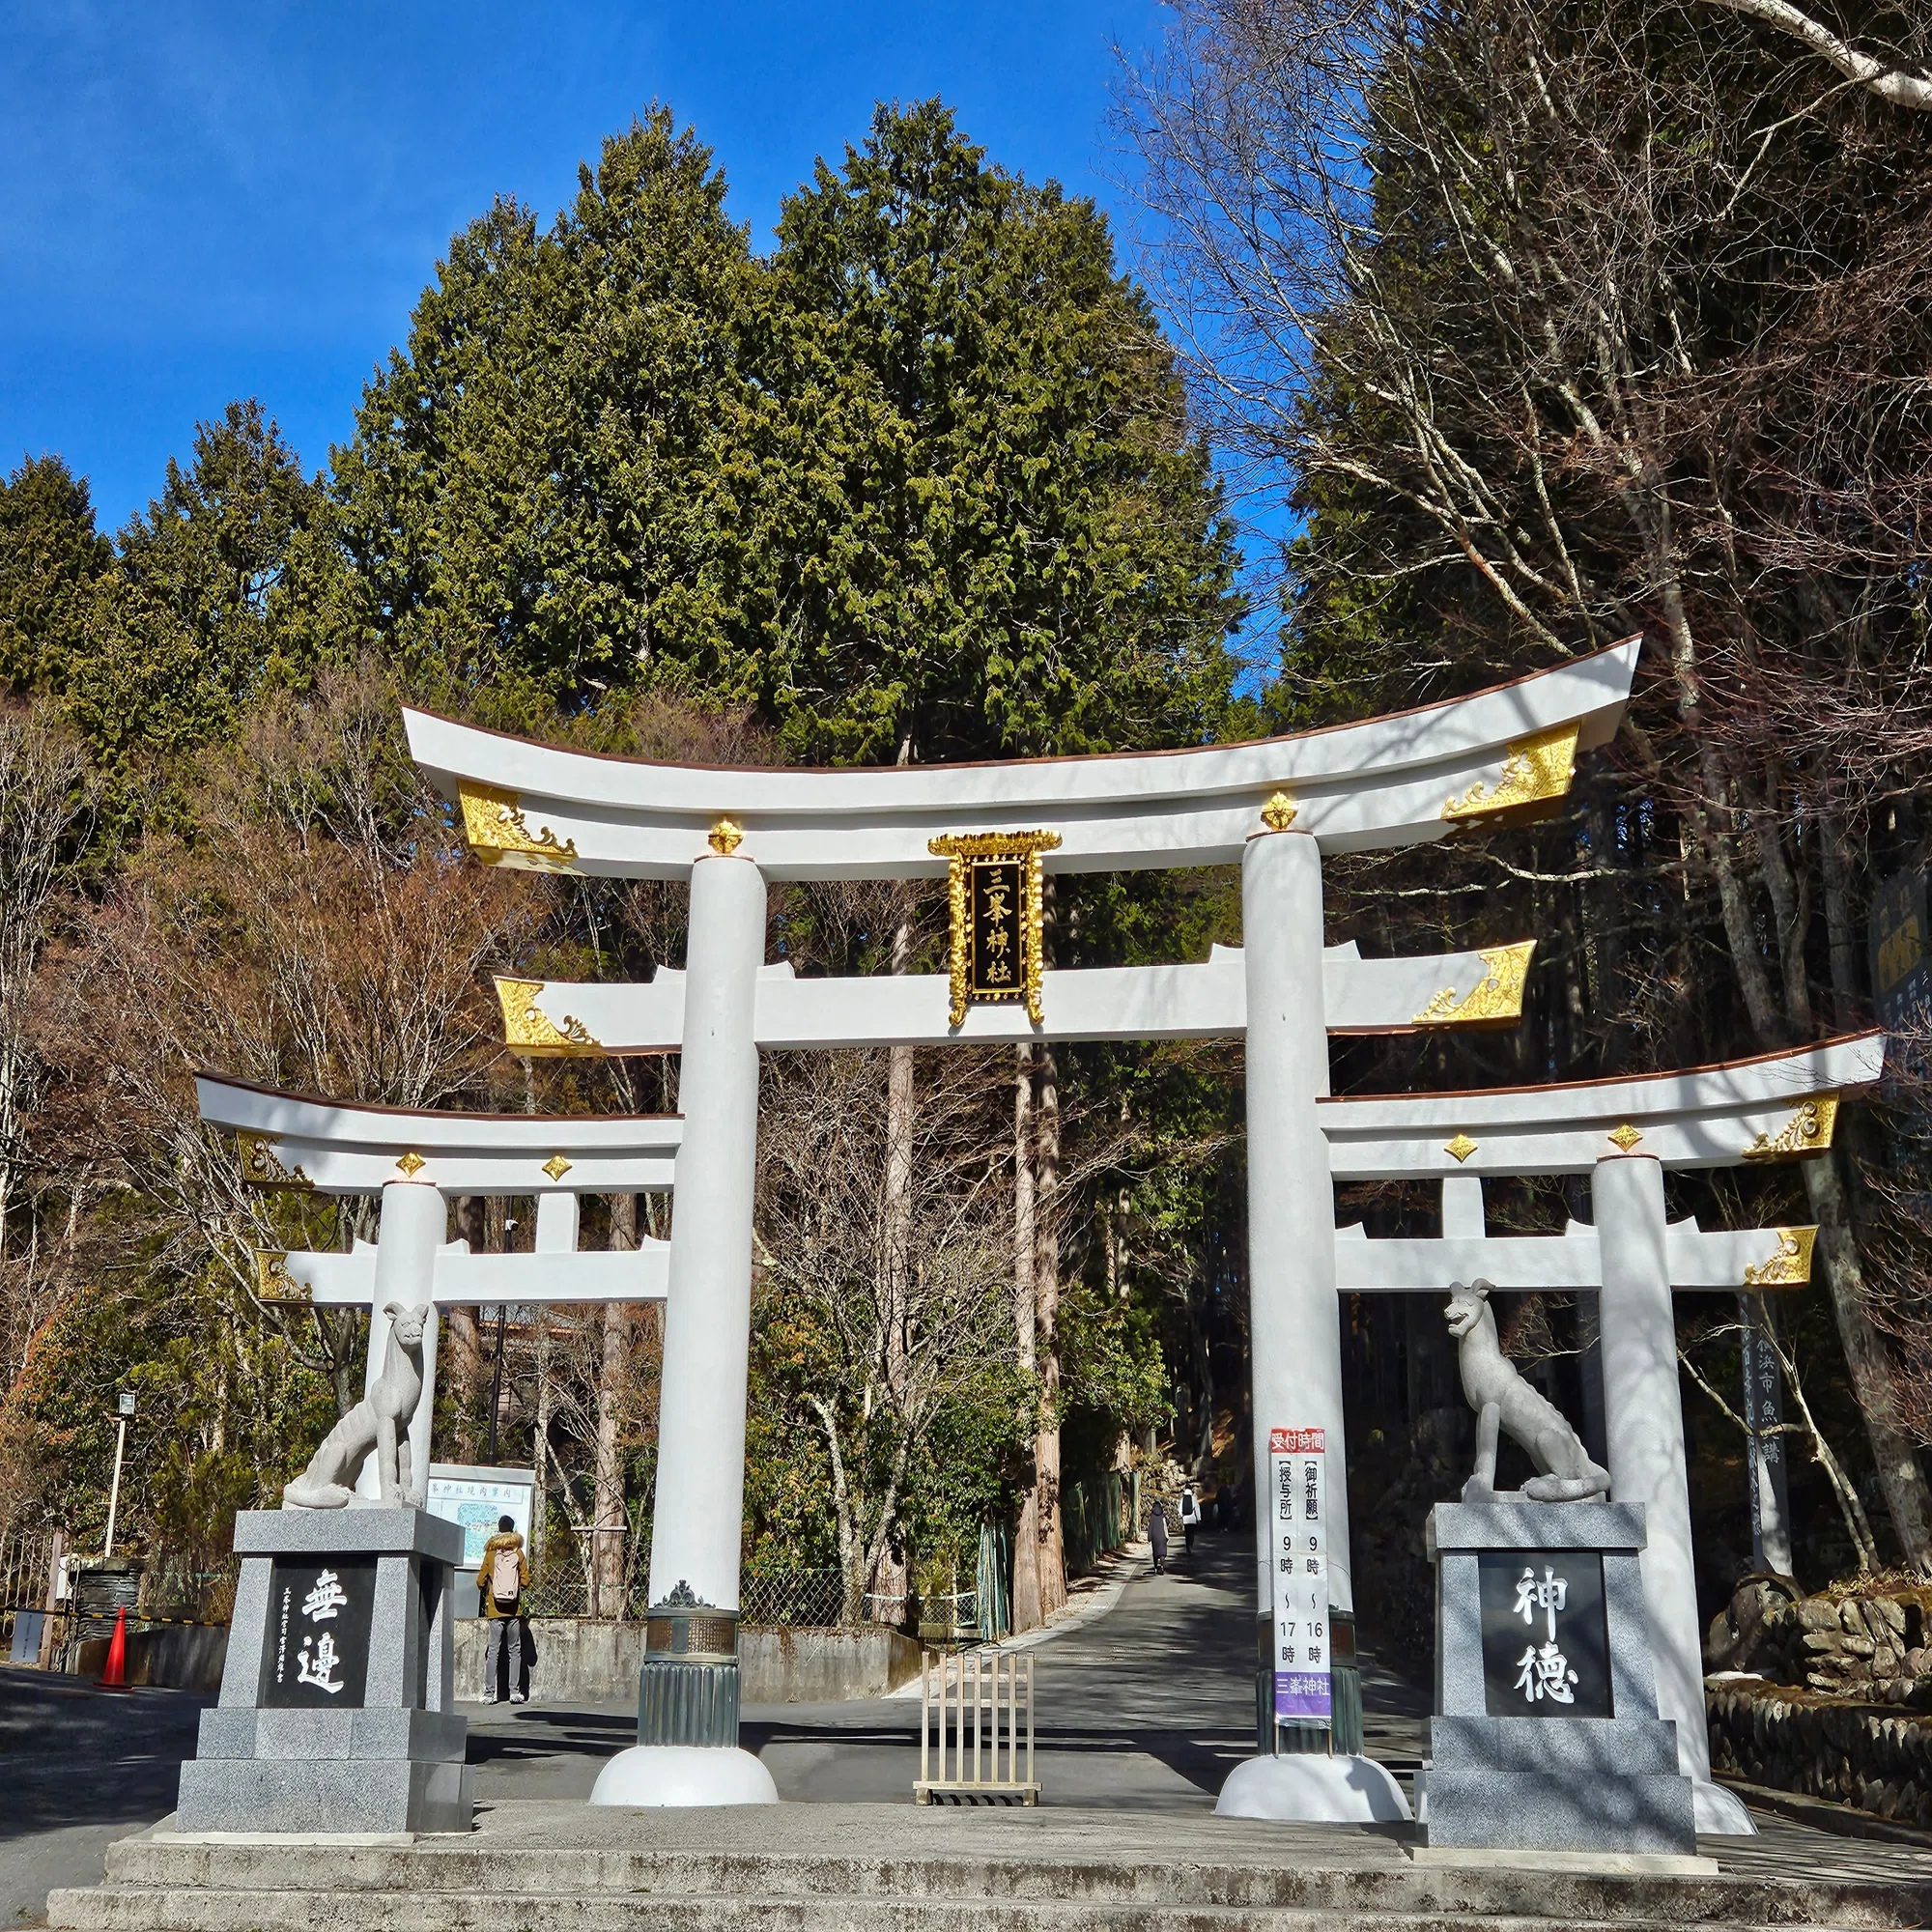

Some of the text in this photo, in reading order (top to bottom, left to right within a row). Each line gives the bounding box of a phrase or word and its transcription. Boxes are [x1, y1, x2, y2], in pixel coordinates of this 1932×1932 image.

[982, 867, 1012, 983] 三峯神社
[1271, 1433, 1324, 1450] 受付時間
[1756, 1337, 1780, 1463] 横浜市魚講
[1276, 1677, 1330, 1696] 三峯神社
[1513, 1564, 1579, 1704] 神徳
